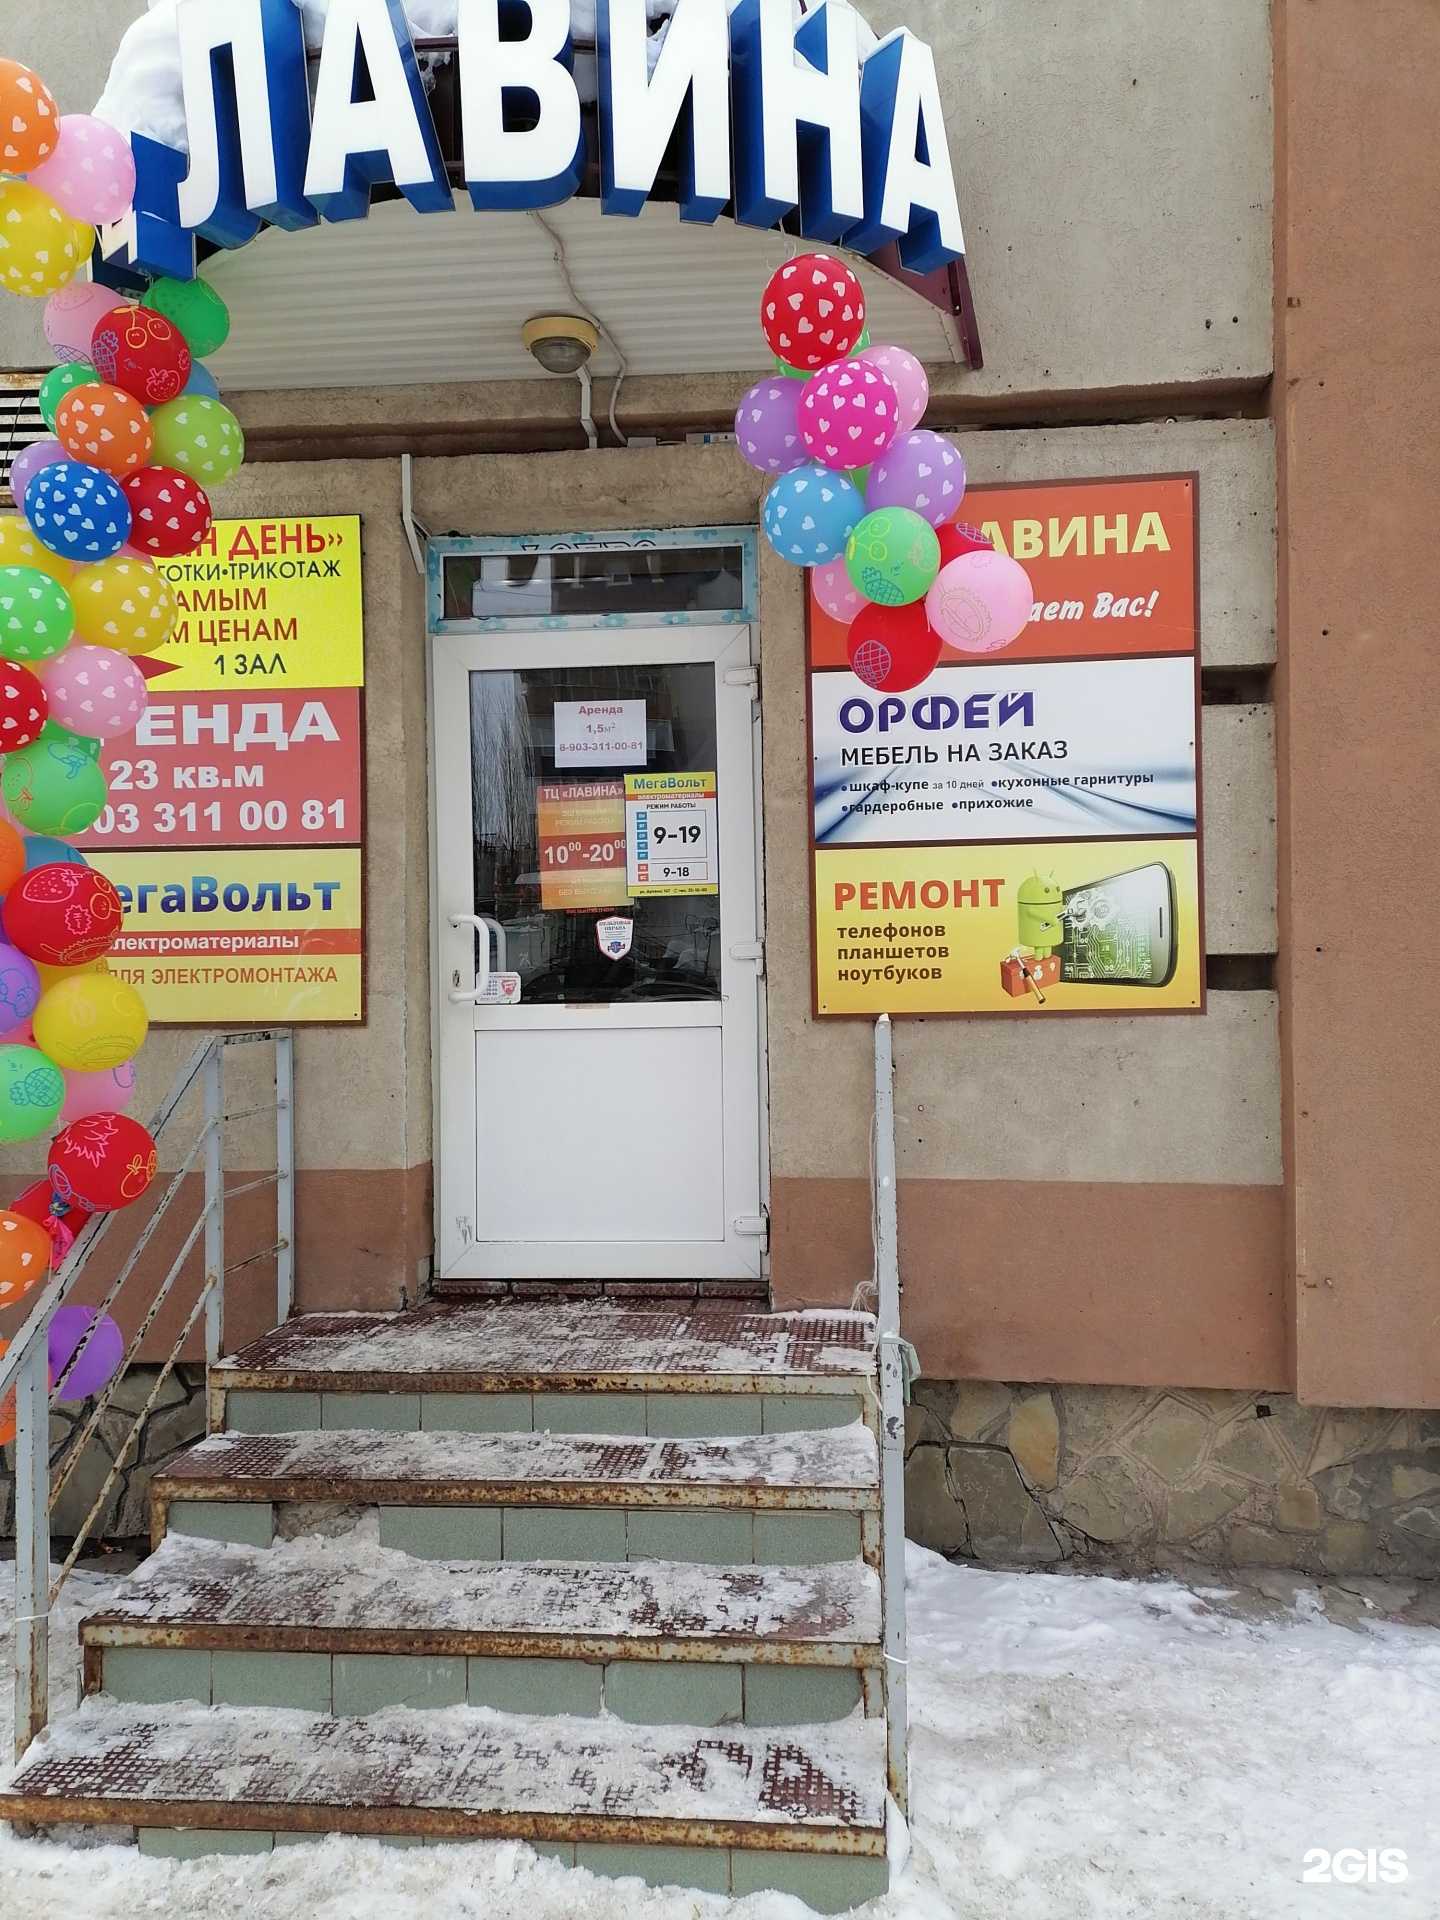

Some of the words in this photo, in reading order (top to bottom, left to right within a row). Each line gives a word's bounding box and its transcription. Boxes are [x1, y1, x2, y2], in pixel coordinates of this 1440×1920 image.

[178, 0, 966, 262] ЛАВИНА
[184, 525, 217, 557] Н
[1093, 590, 1160, 619] Вас!
[198, 617, 298, 646] ЦЕНАМ
[214, 654, 226, 676] 1
[234, 653, 287, 675] ЗАЛ
[579, 705, 624, 716] Аренда
[839, 691, 1035, 733] ОРФЕЙ
[559, 741, 643, 752] 8-903-311-00-81
[841, 745, 939, 766] МЕБЕЛЬ
[948, 743, 981, 763] НА
[988, 740, 1069, 762] ЗАКАЗ
[109, 760, 158, 791] 23
[173, 765, 264, 789] кв.м
[633, 777, 706, 790] МегаВольт
[850, 779, 929, 794] шкаф-купе
[946, 780, 957, 789] 10
[960, 777, 985, 790] дней
[998, 777, 1070, 790] кухонные
[1074, 773, 1154, 788] гарнитуры
[543, 788, 560, 801] ТЦ
[670, 802, 697, 810] РАБОТЫ
[850, 799, 945, 815] гардеробные
[959, 797, 1034, 812] прихожие
[82, 802, 140, 834] 03
[153, 801, 222, 833] 311
[240, 800, 287, 831] 00
[301, 798, 345, 830] 81
[653, 825, 702, 845] 9-19
[663, 867, 690, 878] 9-18
[834, 878, 1006, 911] РЕМОНТ
[837, 923, 946, 942] телефонов
[108, 934, 299, 953] лектроматериалы
[837, 944, 950, 962] планшетов
[152, 966, 338, 984] ЭЛЕКТРОМОНТАЖА
[837, 966, 943, 985] ноутбуков
